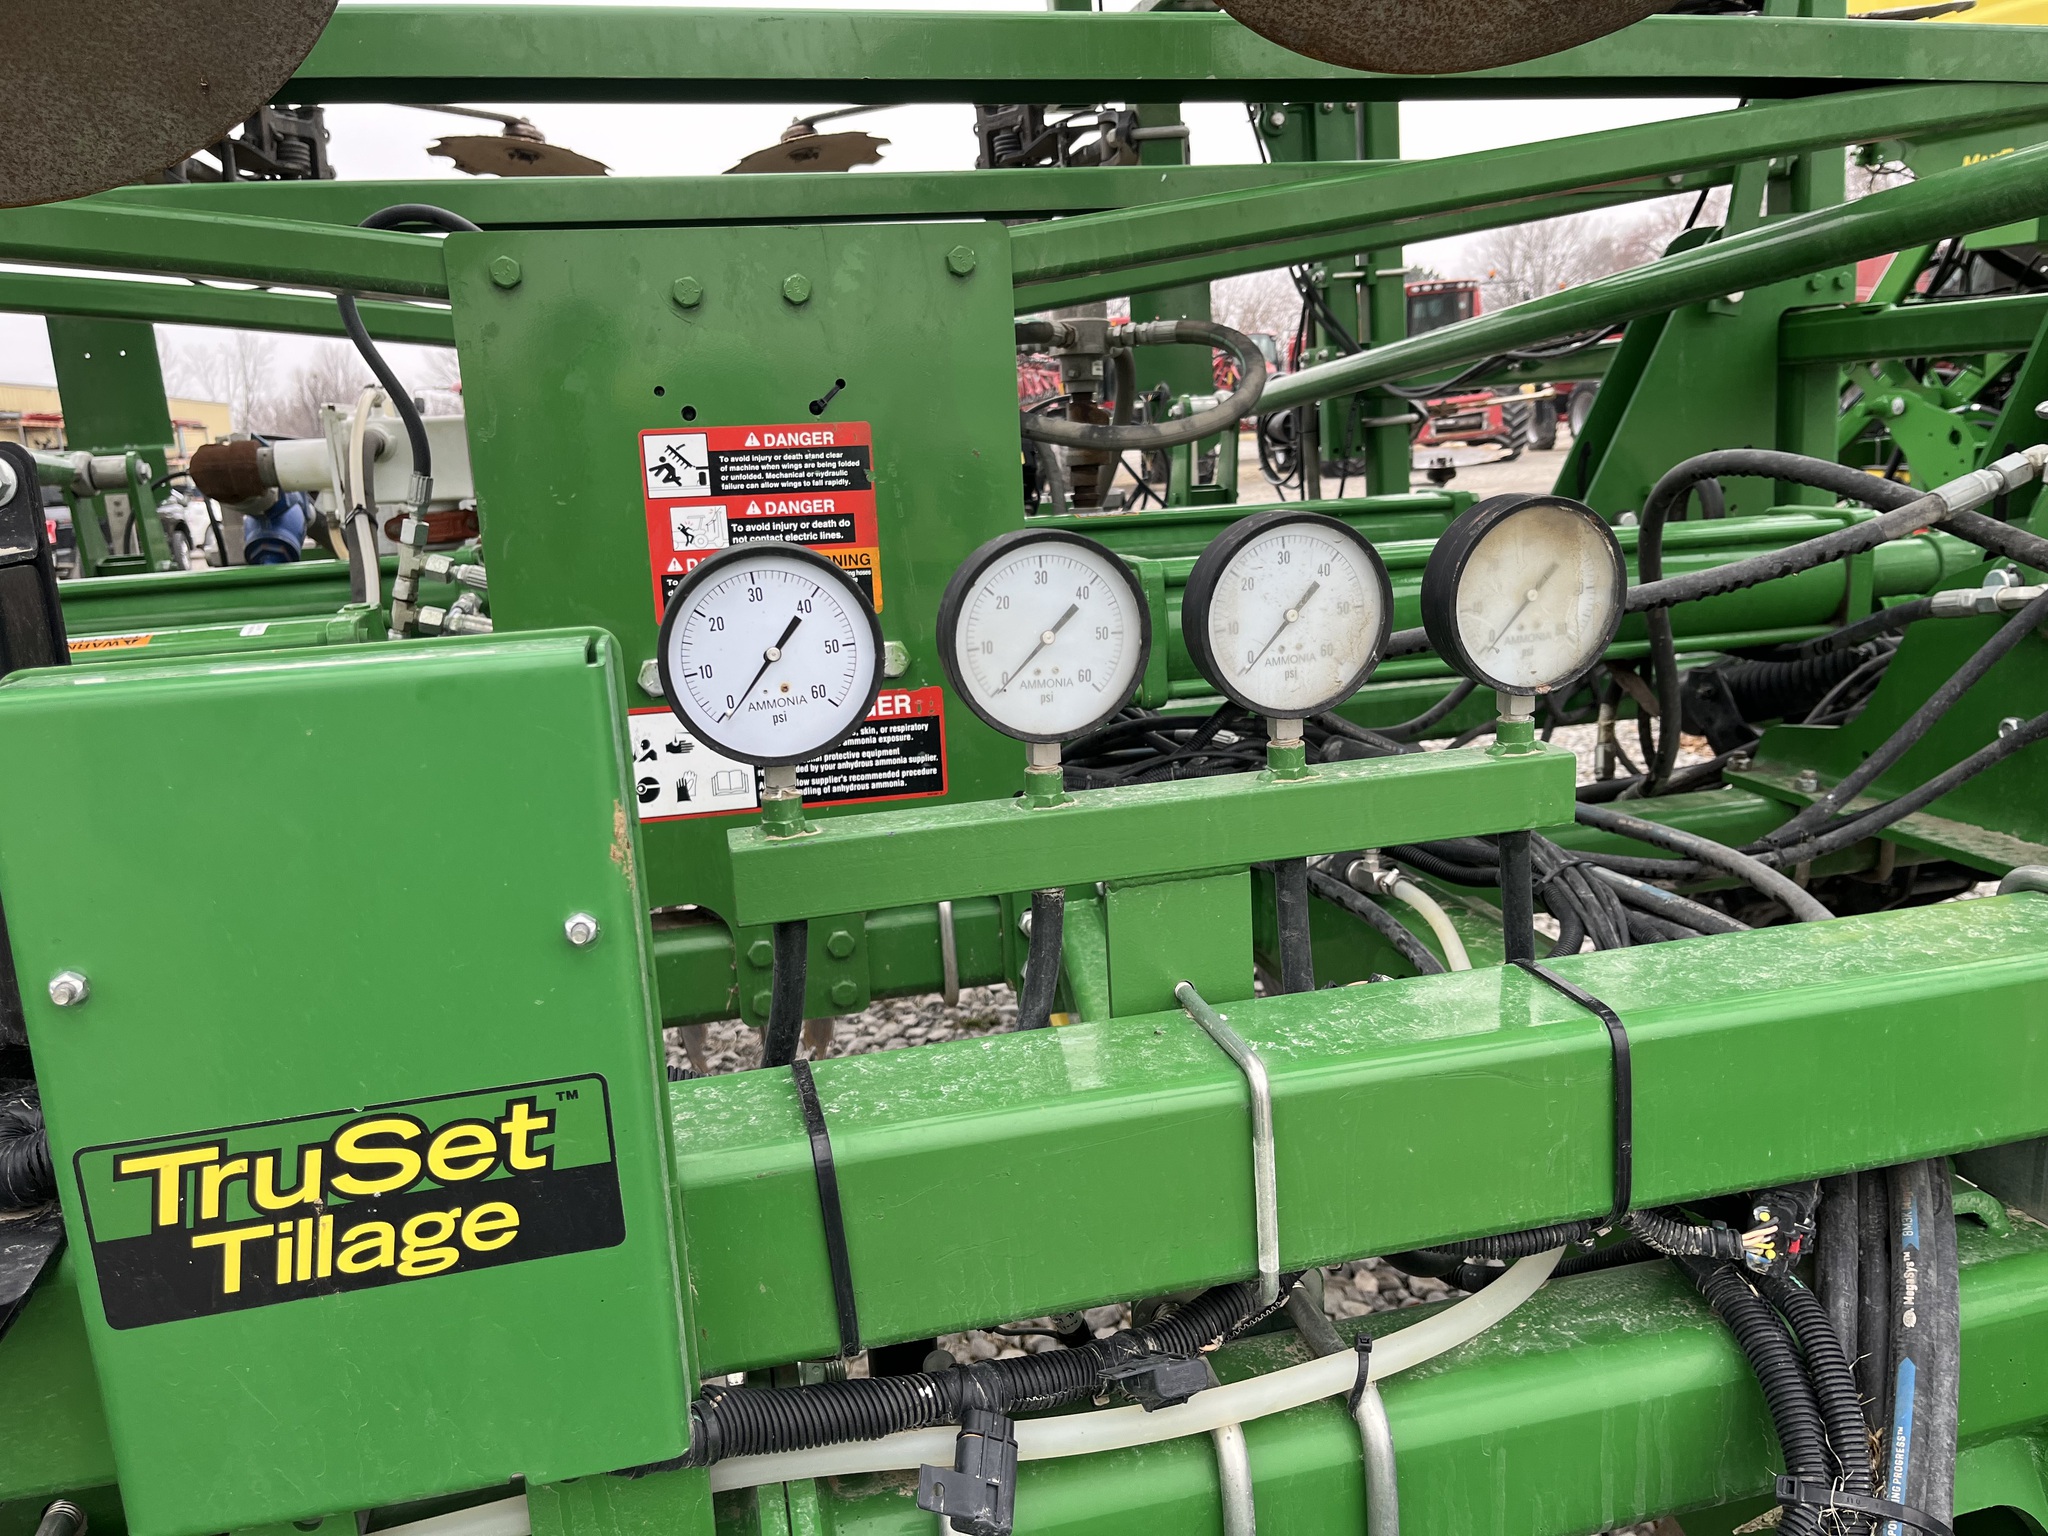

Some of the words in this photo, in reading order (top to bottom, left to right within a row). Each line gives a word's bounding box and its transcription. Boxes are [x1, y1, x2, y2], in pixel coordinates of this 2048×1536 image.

[764, 432, 834, 447] DANGER
[751, 454, 772, 463] injury
[805, 452, 824, 460] stand
[729, 463, 759, 471] machine
[761, 462, 780, 470] when
[782, 461, 802, 470] wings
[817, 460, 836, 469] being
[730, 472, 764, 481] unfolded.
[766, 471, 805, 479] Mechanical
[815, 470, 848, 478] hydraulic
[781, 480, 802, 488] wings
[825, 478, 851, 486] rapidly.
[765, 499, 835, 515] DANGER
[731, 524, 744, 532] To
[746, 522, 770, 532] avoid
[772, 521, 798, 532] injury
[812, 519, 837, 528] death
[838, 518, 851, 527] do
[732, 535, 748, 544] not
[750, 533, 783, 542] contact
[785, 532, 818, 541] electric
[820, 531, 844, 539] lines.
[1277, 551, 1290, 565] 30
[1317, 563, 1331, 577] 40
[1034, 571, 1048, 585] 30
[1241, 577, 1254, 591] 20
[748, 587, 763, 602] 30
[1075, 586, 1090, 600] 40
[797, 599, 812, 614] 40
[995, 596, 1010, 610] 20
[1337, 602, 1350, 615] 50
[709, 616, 724, 632] 20
[1228, 621, 1239, 635] 10
[1095, 626, 1109, 640] 50
[824, 639, 840, 654] 50
[981, 640, 993, 655] 10
[1320, 643, 1334, 657] 60
[1247, 650, 1254, 664] 0
[1264, 653, 1316, 667] AMMONIA
[699, 665, 713, 679] 10
[1001, 672, 1009, 685] 0
[1078, 668, 1092, 683] 60
[1284, 668, 1298, 681] psi
[1019, 677, 1074, 690] AMMONIA
[811, 684, 826, 699] 60
[1040, 691, 1054, 705] psi
[726, 695, 734, 709] 0
[748, 695, 808, 712] AMMONIA
[772, 711, 788, 726] psi
[860, 727, 878, 735] skin,
[890, 722, 928, 733] respiratory
[842, 736, 876, 746] ammonia
[878, 734, 914, 744] exposure.
[824, 750, 860, 761] protective
[861, 748, 900, 759] equipment
[810, 763, 819, 773] by
[820, 762, 836, 772] your
[837, 758, 873, 770] anhydrous
[875, 756, 908, 766] ammonia
[908, 754, 938, 764] supplier.
[811, 774, 848, 786] supplier's
[849, 770, 900, 782] recommended
[901, 768, 937, 778] procedure
[823, 785, 831, 793] of
[832, 782, 870, 793] anhydrous
[871, 779, 907, 789] ammonia.
[120, 1102, 550, 1227] TruSet
[1902, 1210, 1914, 1237] 8M3K
[191, 1200, 521, 1294] Tillage
